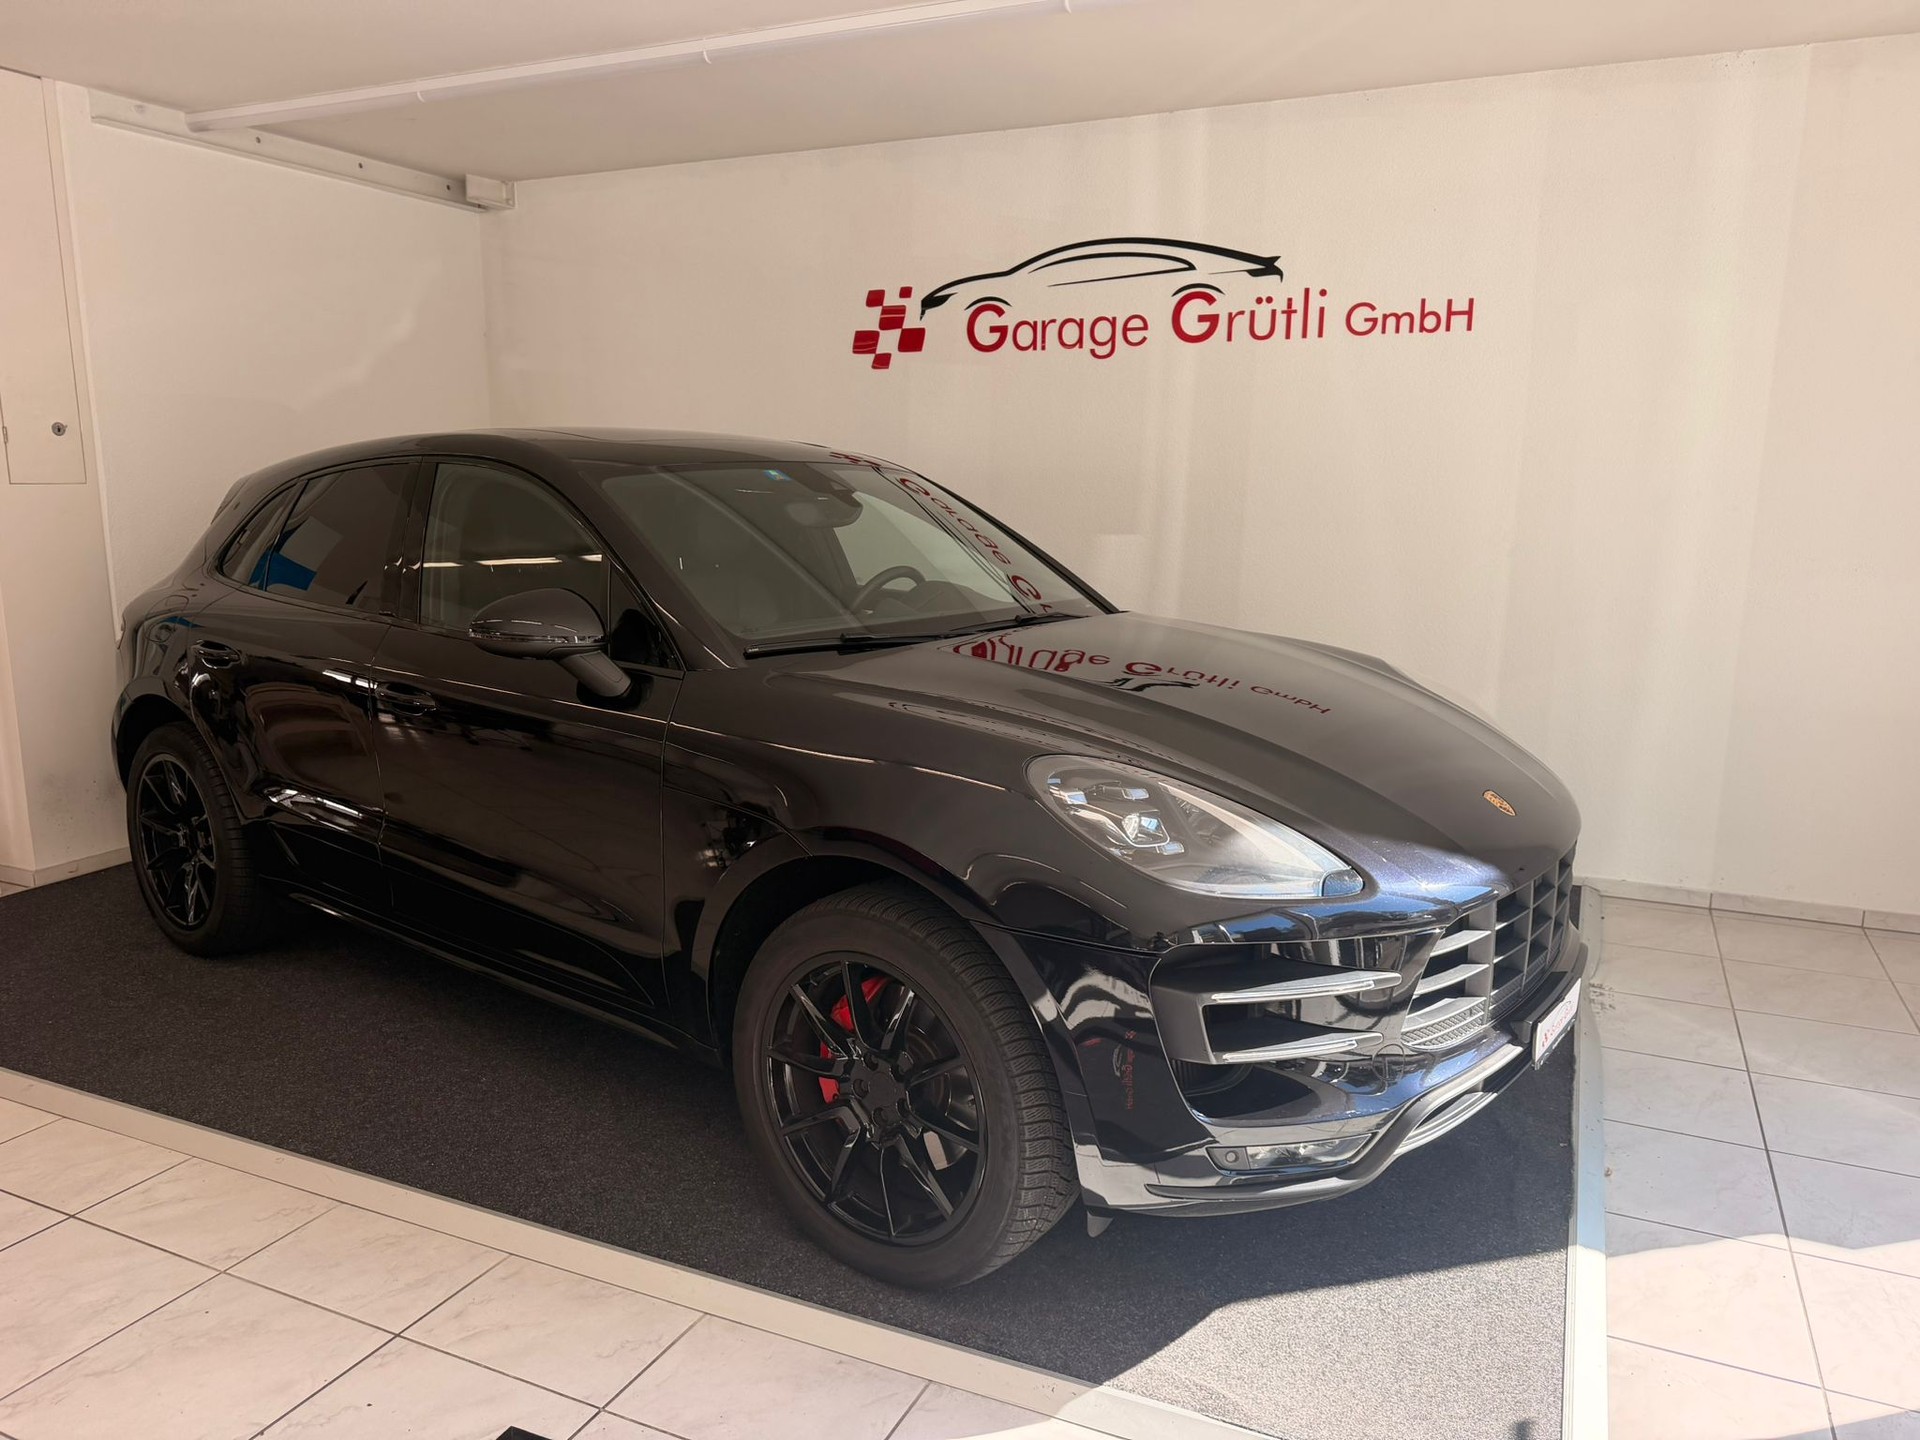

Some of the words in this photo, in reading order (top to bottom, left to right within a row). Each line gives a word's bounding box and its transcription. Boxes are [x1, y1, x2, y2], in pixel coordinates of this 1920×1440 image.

[966, 304, 1150, 360] Garage
[1171, 288, 1328, 344] Grütli
[1345, 299, 1474, 337] GmbH
